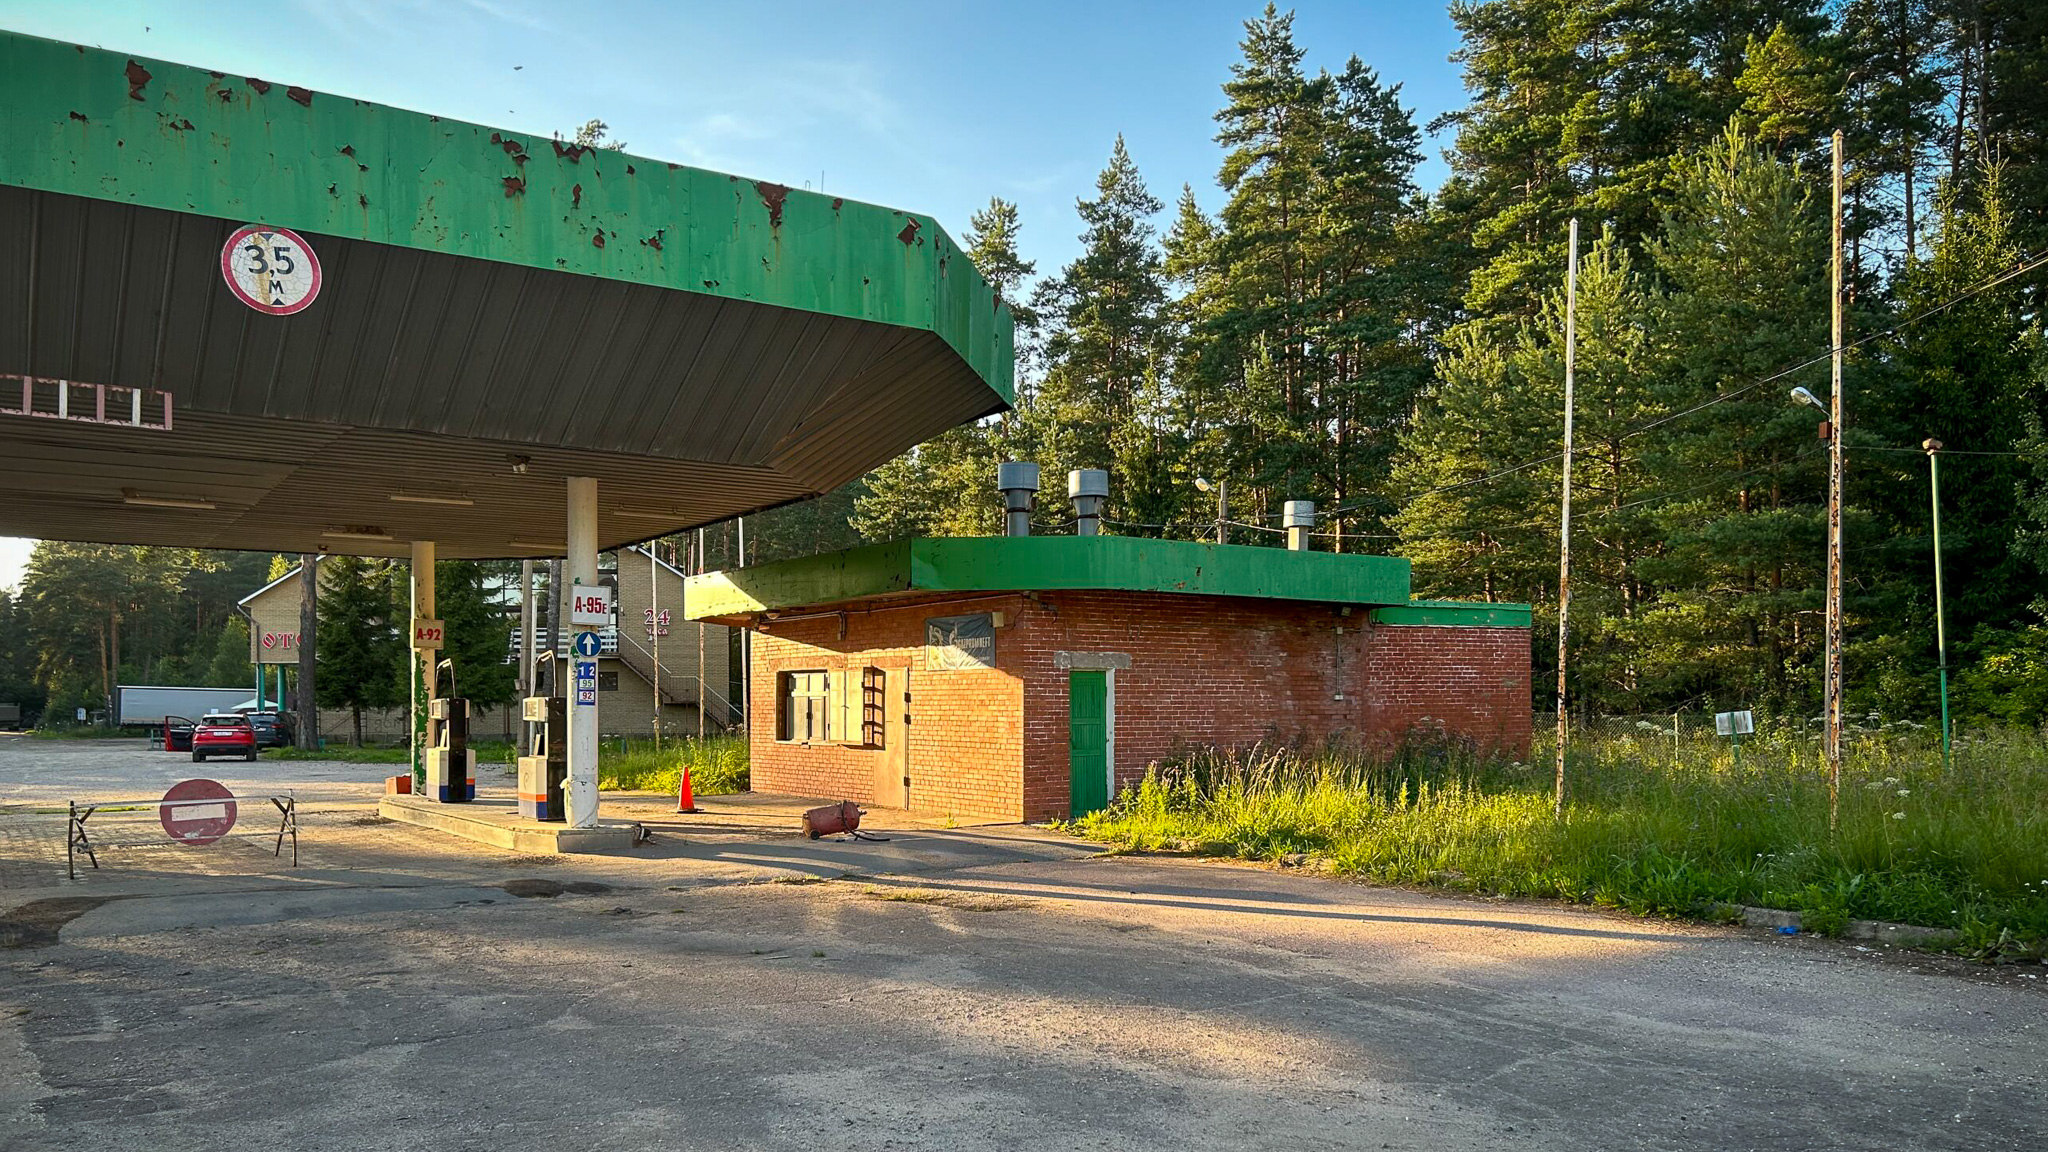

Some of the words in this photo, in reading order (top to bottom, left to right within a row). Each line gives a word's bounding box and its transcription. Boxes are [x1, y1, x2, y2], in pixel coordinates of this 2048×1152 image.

[244, 244, 295, 277] 3,5
[644, 609, 670, 625] 24
[578, 666, 585, 676] 1
[589, 666, 595, 676] 2
[582, 691, 593, 700] 92
